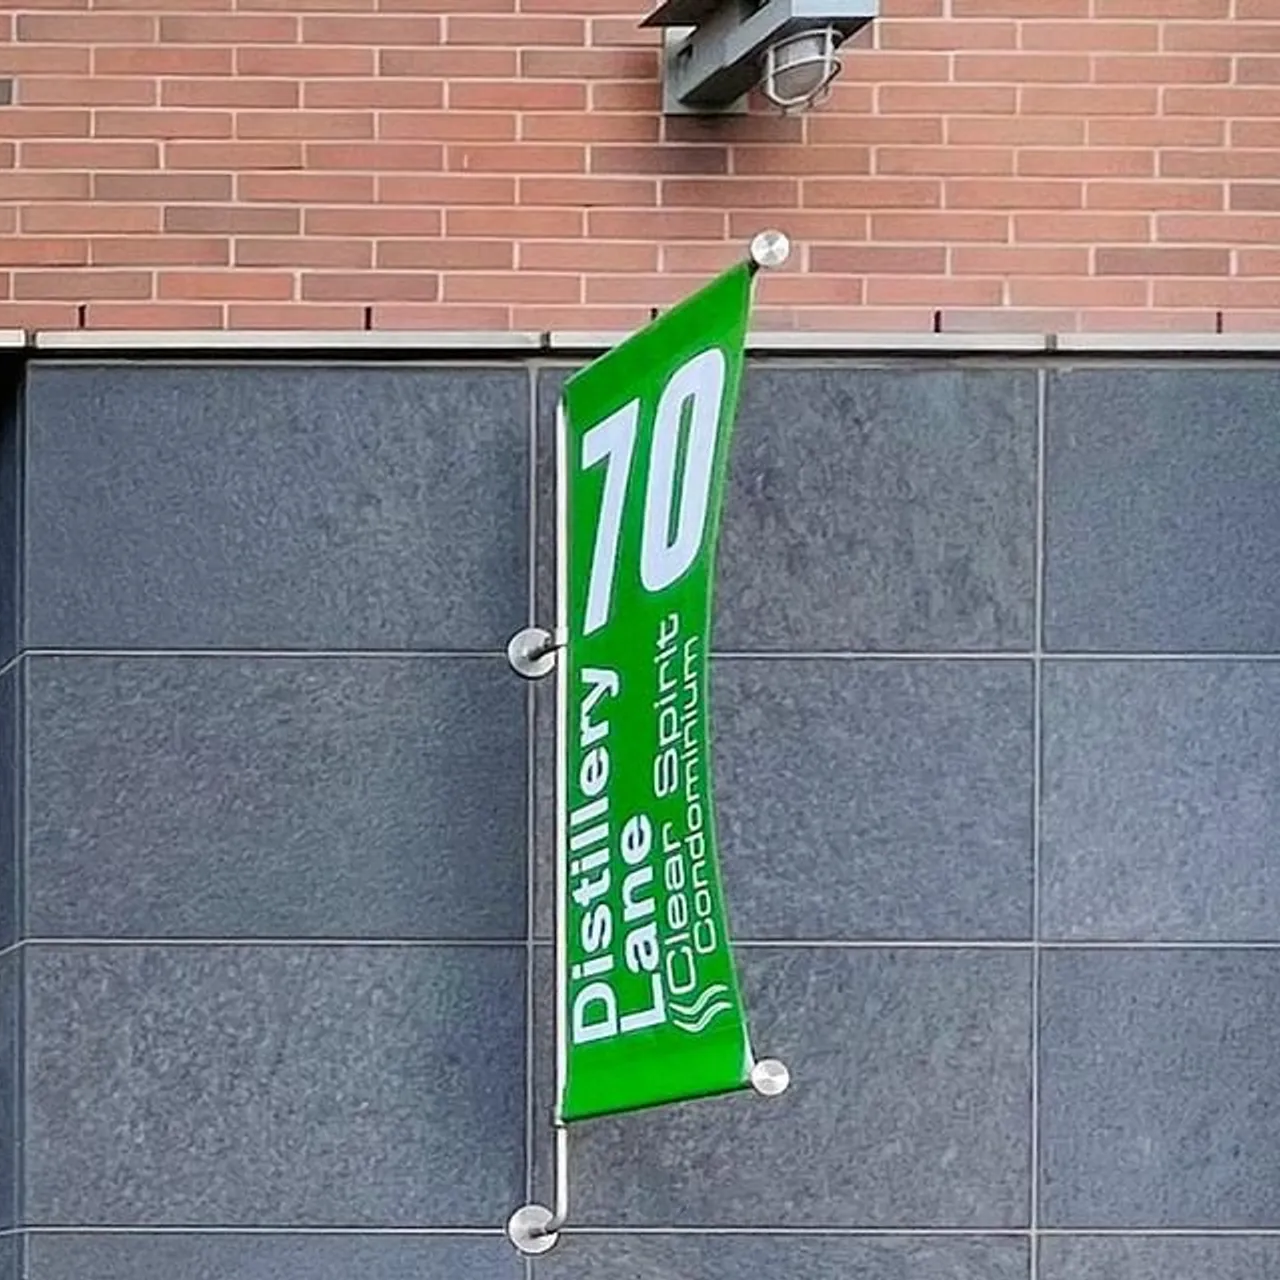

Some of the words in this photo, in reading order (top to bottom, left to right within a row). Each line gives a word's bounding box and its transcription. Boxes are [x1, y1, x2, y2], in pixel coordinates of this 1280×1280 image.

[582, 347, 726, 637] 70
[653, 613, 683, 798] Spirit
[680, 635, 717, 954] Condominium
[570, 667, 620, 1044] Distillery
[619, 814, 667, 1033] Lane
[662, 822, 697, 995] Clear
